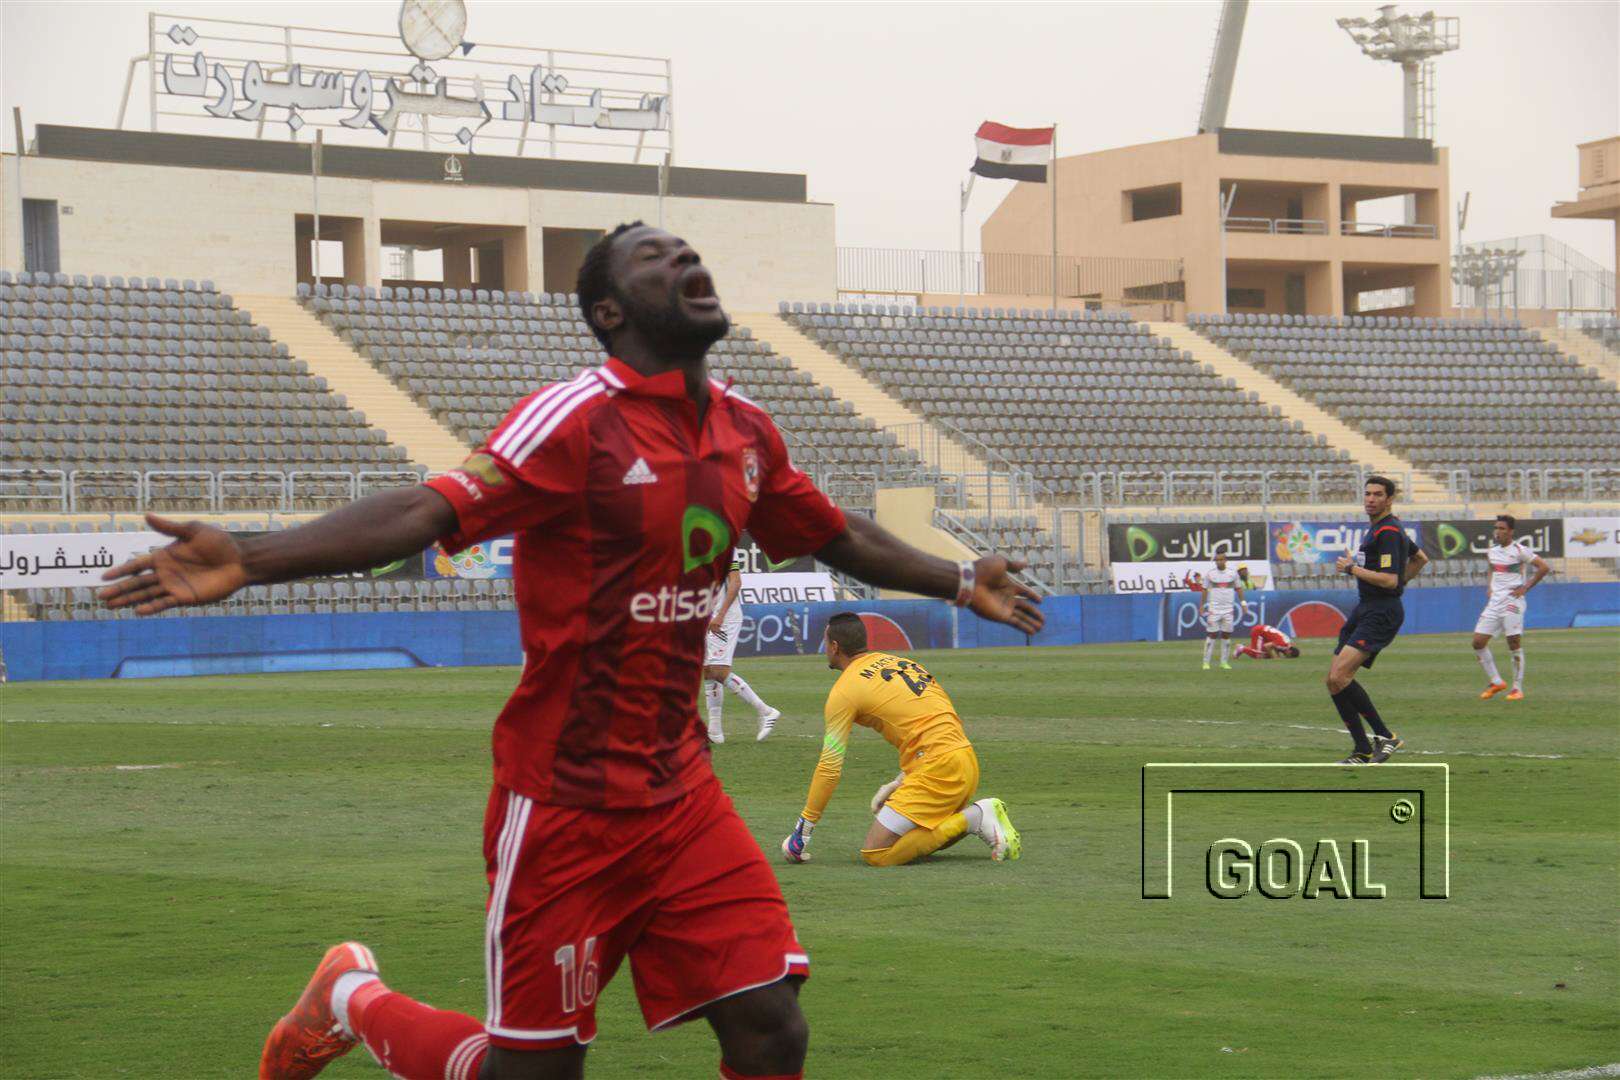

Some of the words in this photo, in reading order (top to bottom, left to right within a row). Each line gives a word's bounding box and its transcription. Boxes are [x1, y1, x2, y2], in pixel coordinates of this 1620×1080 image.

[1162, 528, 1251, 559] اتصالات
[739, 586, 826, 604] EVROLET
[737, 606, 810, 652] epsi
[554, 937, 598, 1013] 16
